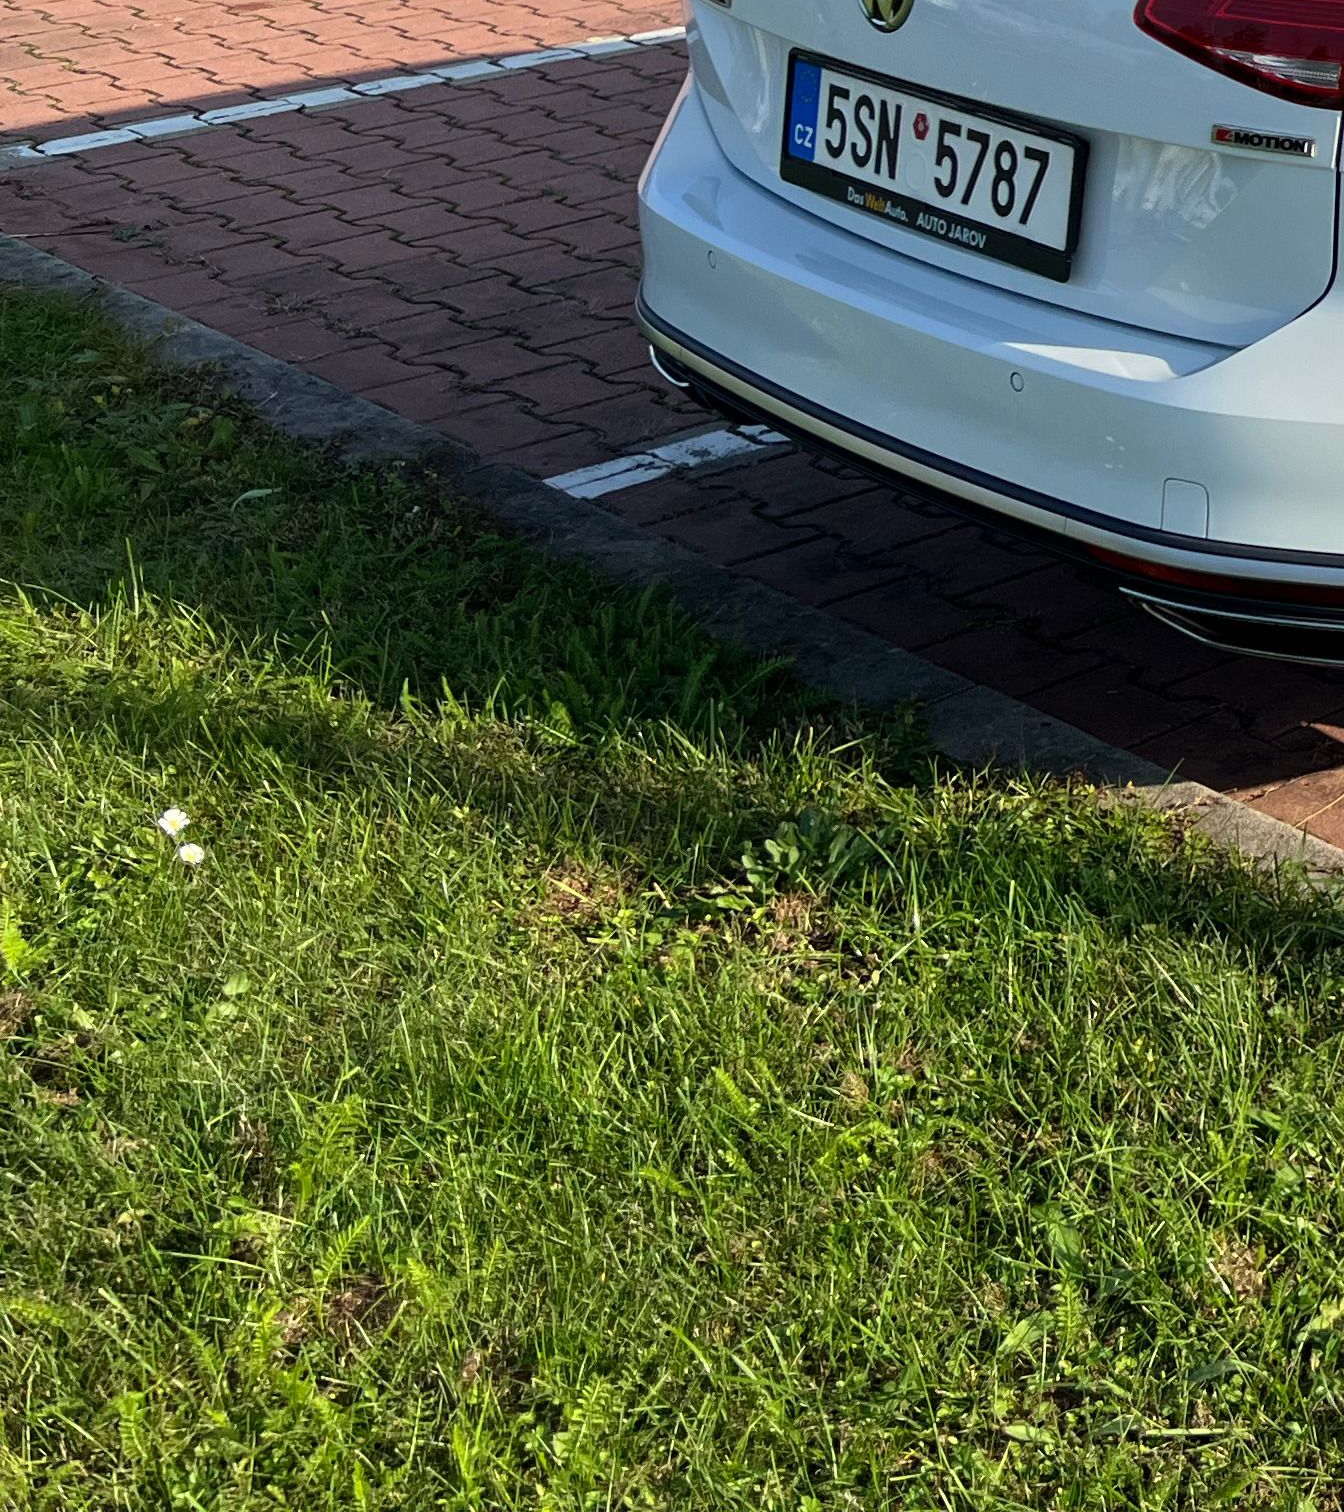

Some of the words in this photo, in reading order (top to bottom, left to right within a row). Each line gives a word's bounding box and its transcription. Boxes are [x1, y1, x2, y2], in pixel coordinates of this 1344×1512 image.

[794, 122, 813, 148] CZ
[824, 83, 902, 180] 5SN
[934, 119, 1050, 226] 5787
[916, 212, 946, 235] AUTO
[948, 223, 986, 249] JAROV
